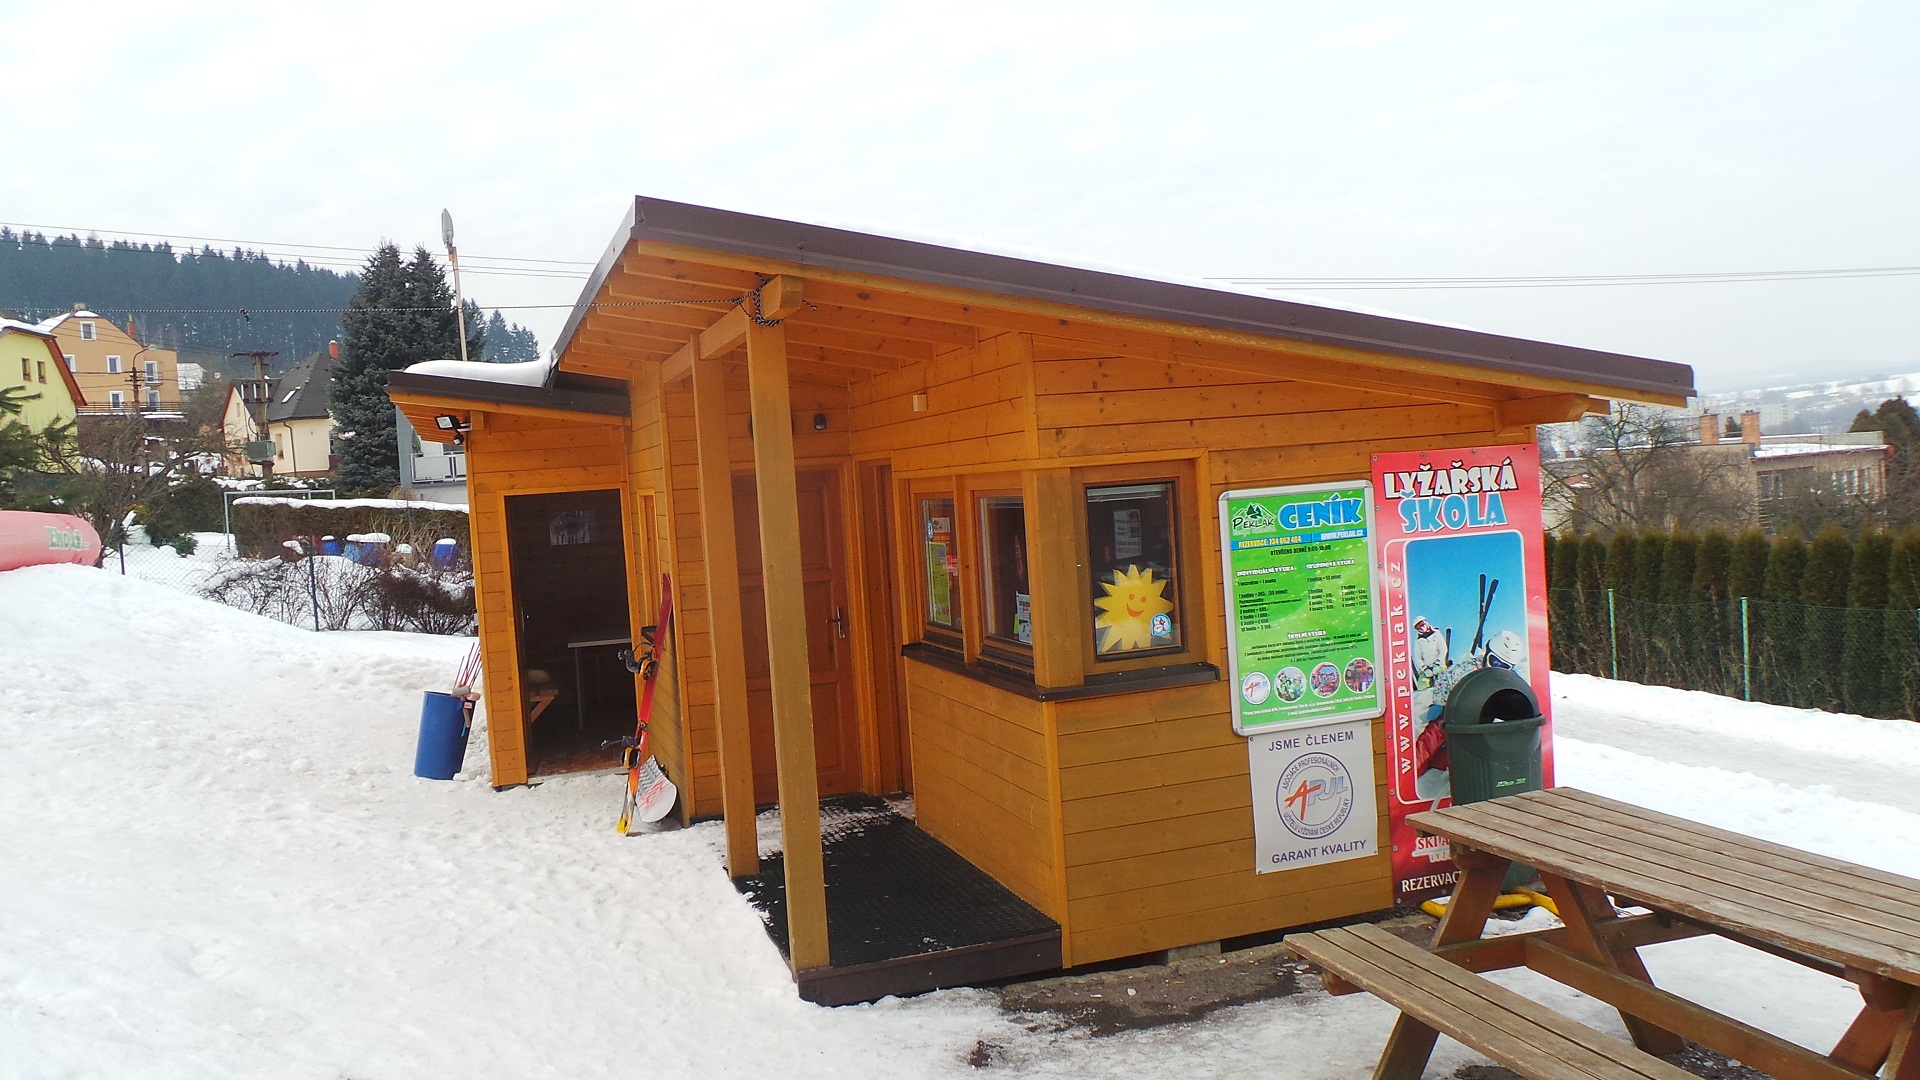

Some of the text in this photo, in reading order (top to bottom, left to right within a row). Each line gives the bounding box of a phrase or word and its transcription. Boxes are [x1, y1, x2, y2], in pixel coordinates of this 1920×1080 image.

[1383, 456, 1519, 500] LYŽAŘSKÁ
[1278, 492, 1363, 530] CENÍK
[1398, 489, 1508, 533] ŠKOLA
[1390, 561, 1411, 775] www.peklak.cz
[1269, 730, 1354, 751] JSME ČLENEM
[1282, 764, 1299, 790] ASOCIACE
[1272, 839, 1367, 864] GARANT KVALITY
[1431, 851, 1447, 861] LYŽ
[1401, 870, 1462, 893] REZERVAC
